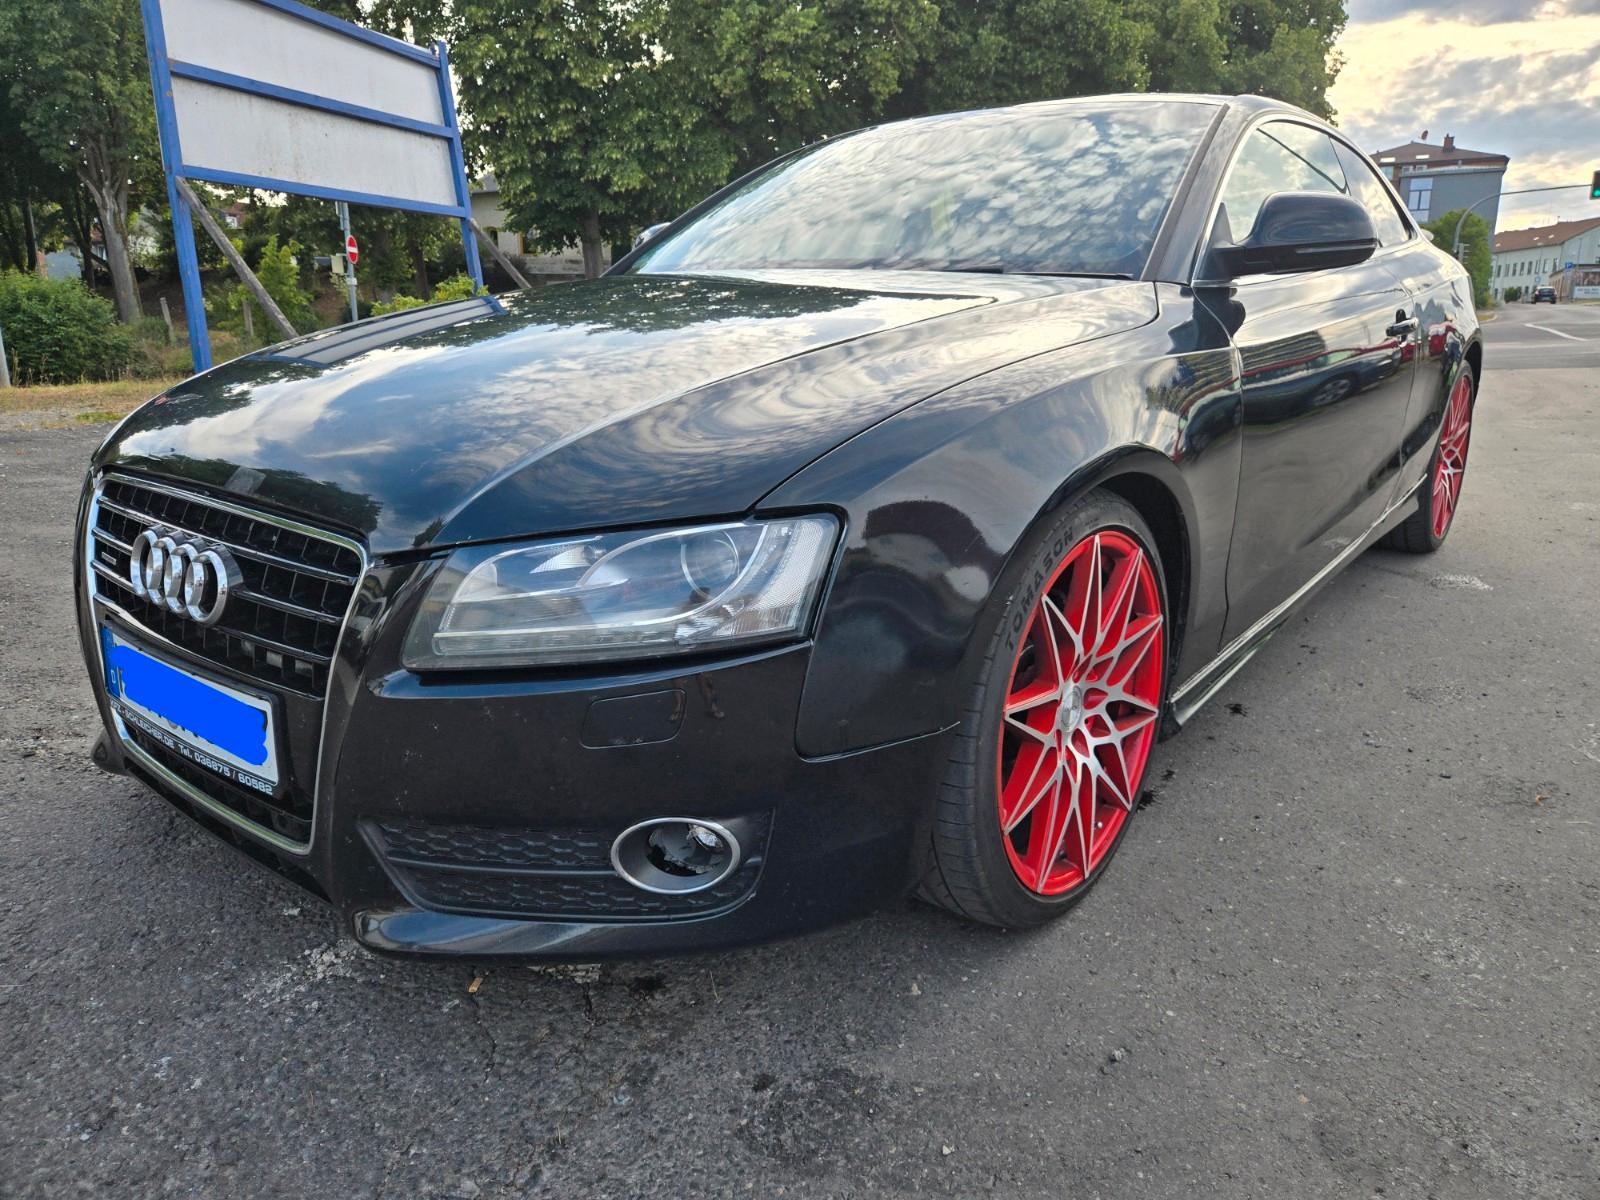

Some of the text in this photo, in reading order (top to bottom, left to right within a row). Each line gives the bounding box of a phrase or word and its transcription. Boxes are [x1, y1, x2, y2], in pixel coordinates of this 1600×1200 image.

[1005, 527, 1074, 650] TOMASON
[178, 744, 192, 758] Tel.
[238, 772, 273, 796] 60582
